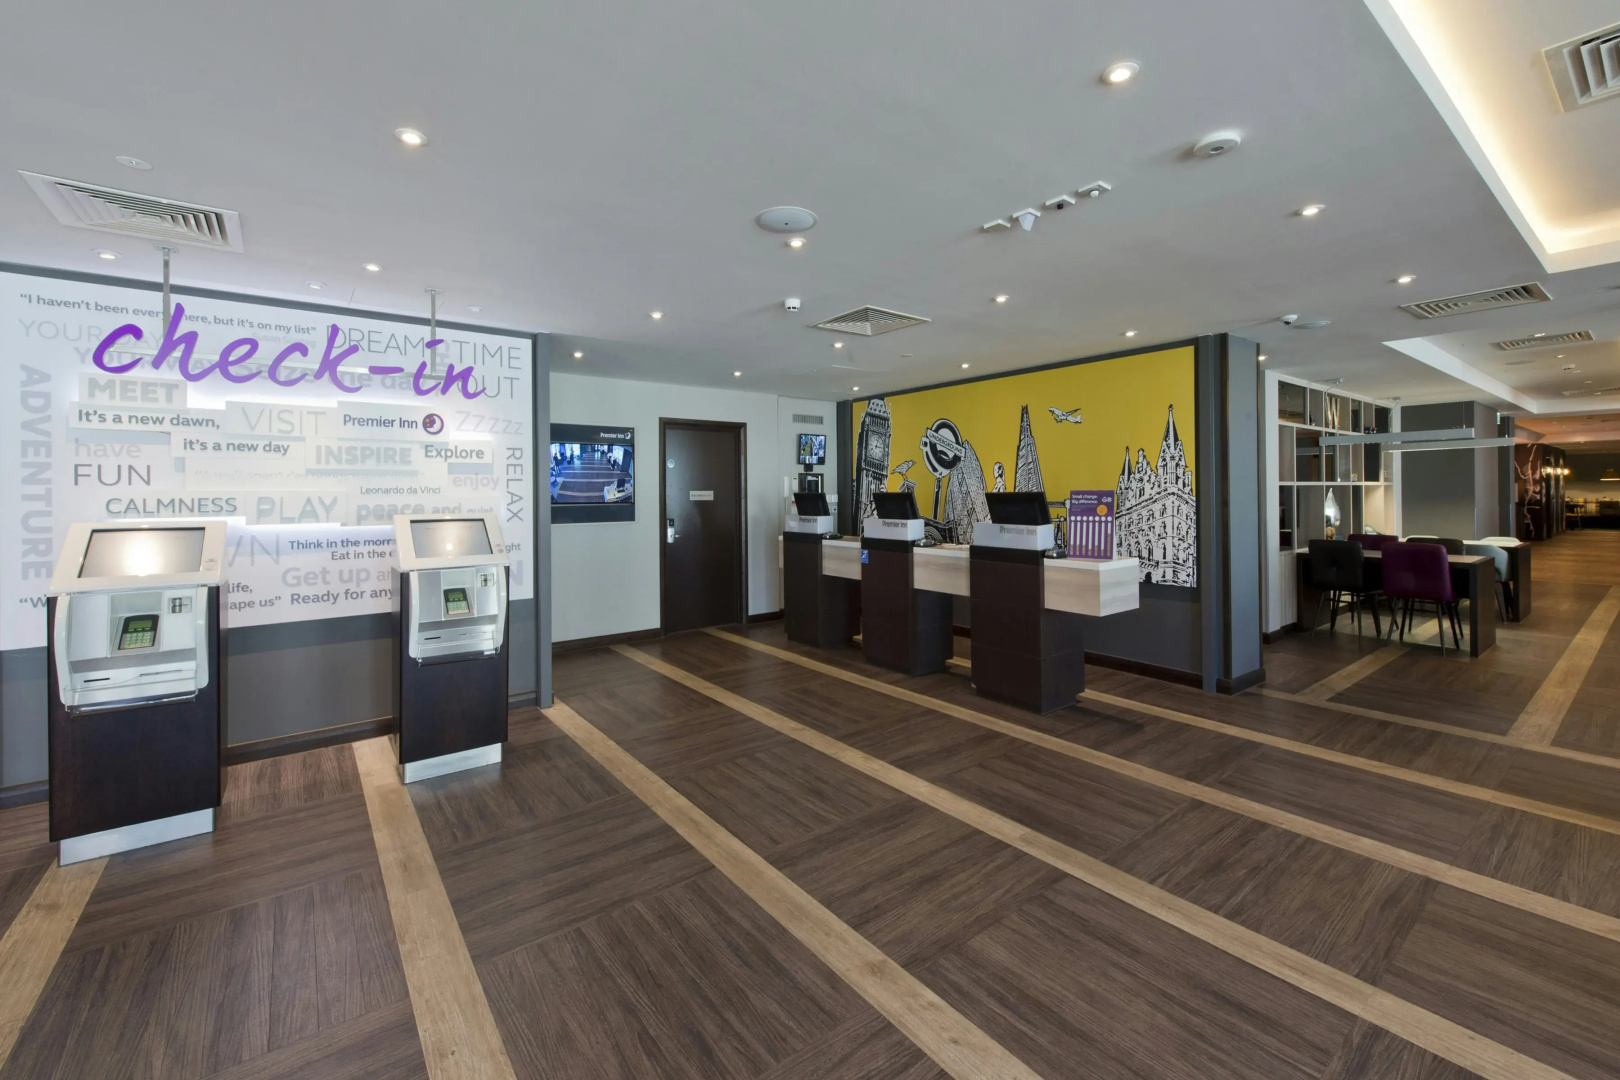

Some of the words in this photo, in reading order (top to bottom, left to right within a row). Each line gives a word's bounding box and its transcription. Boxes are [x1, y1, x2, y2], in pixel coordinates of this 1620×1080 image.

[37, 295, 91, 311] haven’t
[95, 302, 129, 314] been
[213, 315, 234, 326] but
[237, 319, 254, 329] it’s
[257, 322, 271, 330] on
[275, 323, 292, 335] my
[18, 318, 103, 342] YOUR
[93, 303, 486, 399] check-in
[327, 325, 425, 358] DREAM
[452, 339, 522, 370] TIME
[88, 377, 179, 404] MEET
[456, 374, 520, 399] OUT
[78, 409, 107, 423] It’s
[112, 414, 123, 424] a
[128, 415, 165, 425] new
[169, 414, 220, 430] dawn,
[241, 407, 326, 435] VISIT
[343, 414, 396, 428] Premier
[399, 417, 418, 429] Inn
[74, 438, 141, 459] have
[183, 438, 207, 451] it’s
[212, 441, 222, 451] a
[226, 442, 259, 452] new
[263, 441, 290, 456] day
[928, 431, 964, 455] UNDERGROUND
[316, 445, 412, 466] INSPIRE
[424, 445, 485, 463] Explore
[20, 364, 53, 581] ADVENTURE
[74, 463, 151, 486] FUN
[452, 472, 500, 492] enjoy
[360, 486, 404, 495] Leonardo
[407, 486, 417, 495] da
[420, 486, 441, 495] Vinci
[506, 447, 524, 522] RELAX
[105, 497, 238, 514] CALMNESS
[256, 495, 338, 524] PLAY
[356, 503, 426, 526] peace
[431, 503, 463, 514] and
[882, 519, 900, 528] Premier
[999, 525, 1024, 536] Premier
[1026, 527, 1036, 536] Inn
[288, 539, 323, 550] Think
[327, 538, 337, 548] in
[341, 538, 361, 548] the
[331, 551, 351, 561] Eat
[354, 550, 365, 560] in
[367, 550, 386, 559] the
[281, 567, 331, 587] Get
[338, 568, 371, 588] up
[290, 590, 340, 606] Ready
[344, 589, 366, 600] for
